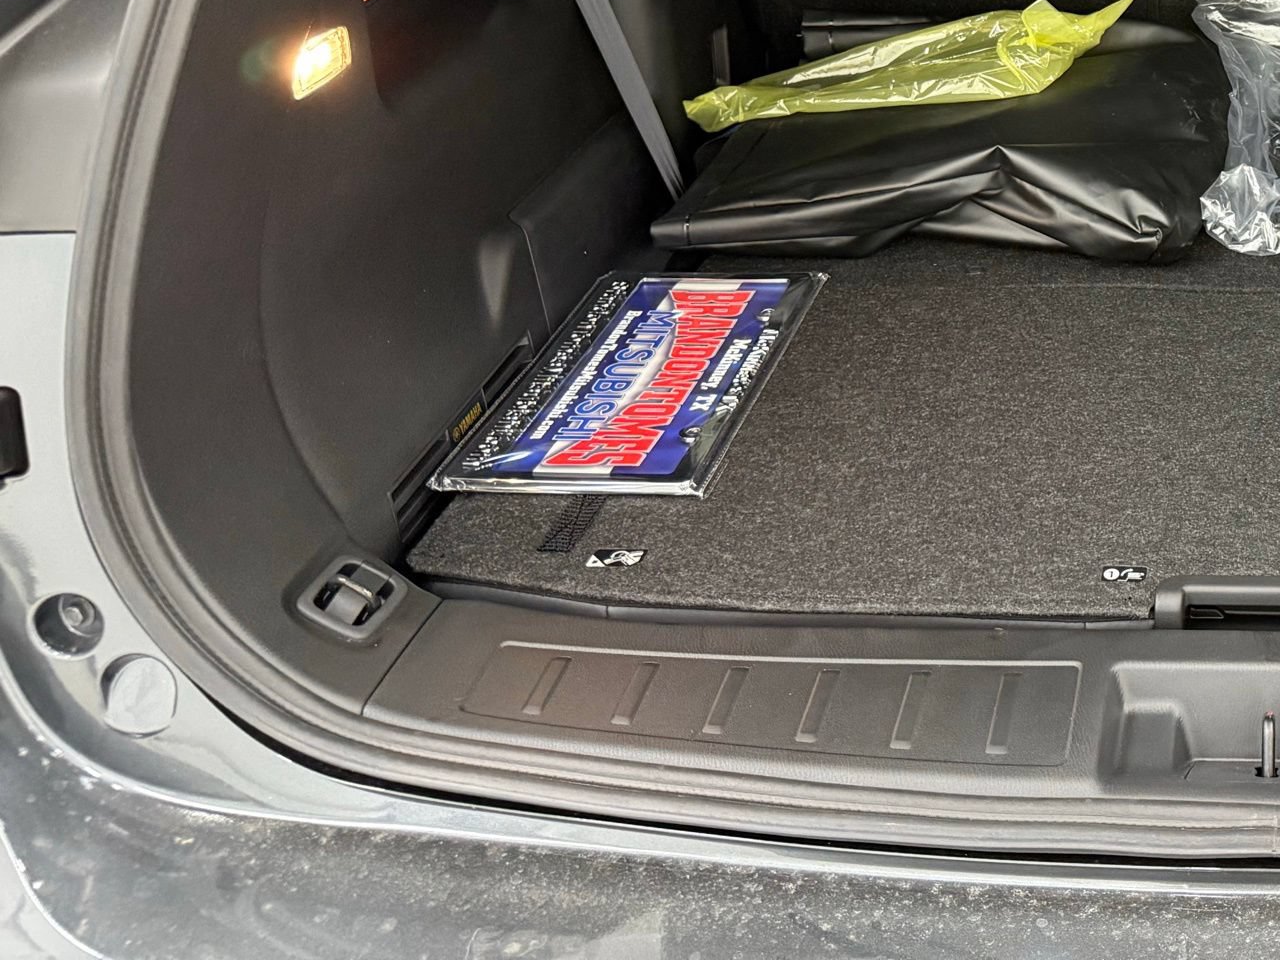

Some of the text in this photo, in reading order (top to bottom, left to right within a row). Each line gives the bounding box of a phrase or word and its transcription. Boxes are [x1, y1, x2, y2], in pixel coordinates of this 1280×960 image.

[458, 401, 483, 435] YAMAHA
[529, 309, 643, 440] BrandonTomesMitsubishi.com
[551, 309, 677, 441] MITSUBISHI
[688, 339, 752, 411] McKinney, TX
